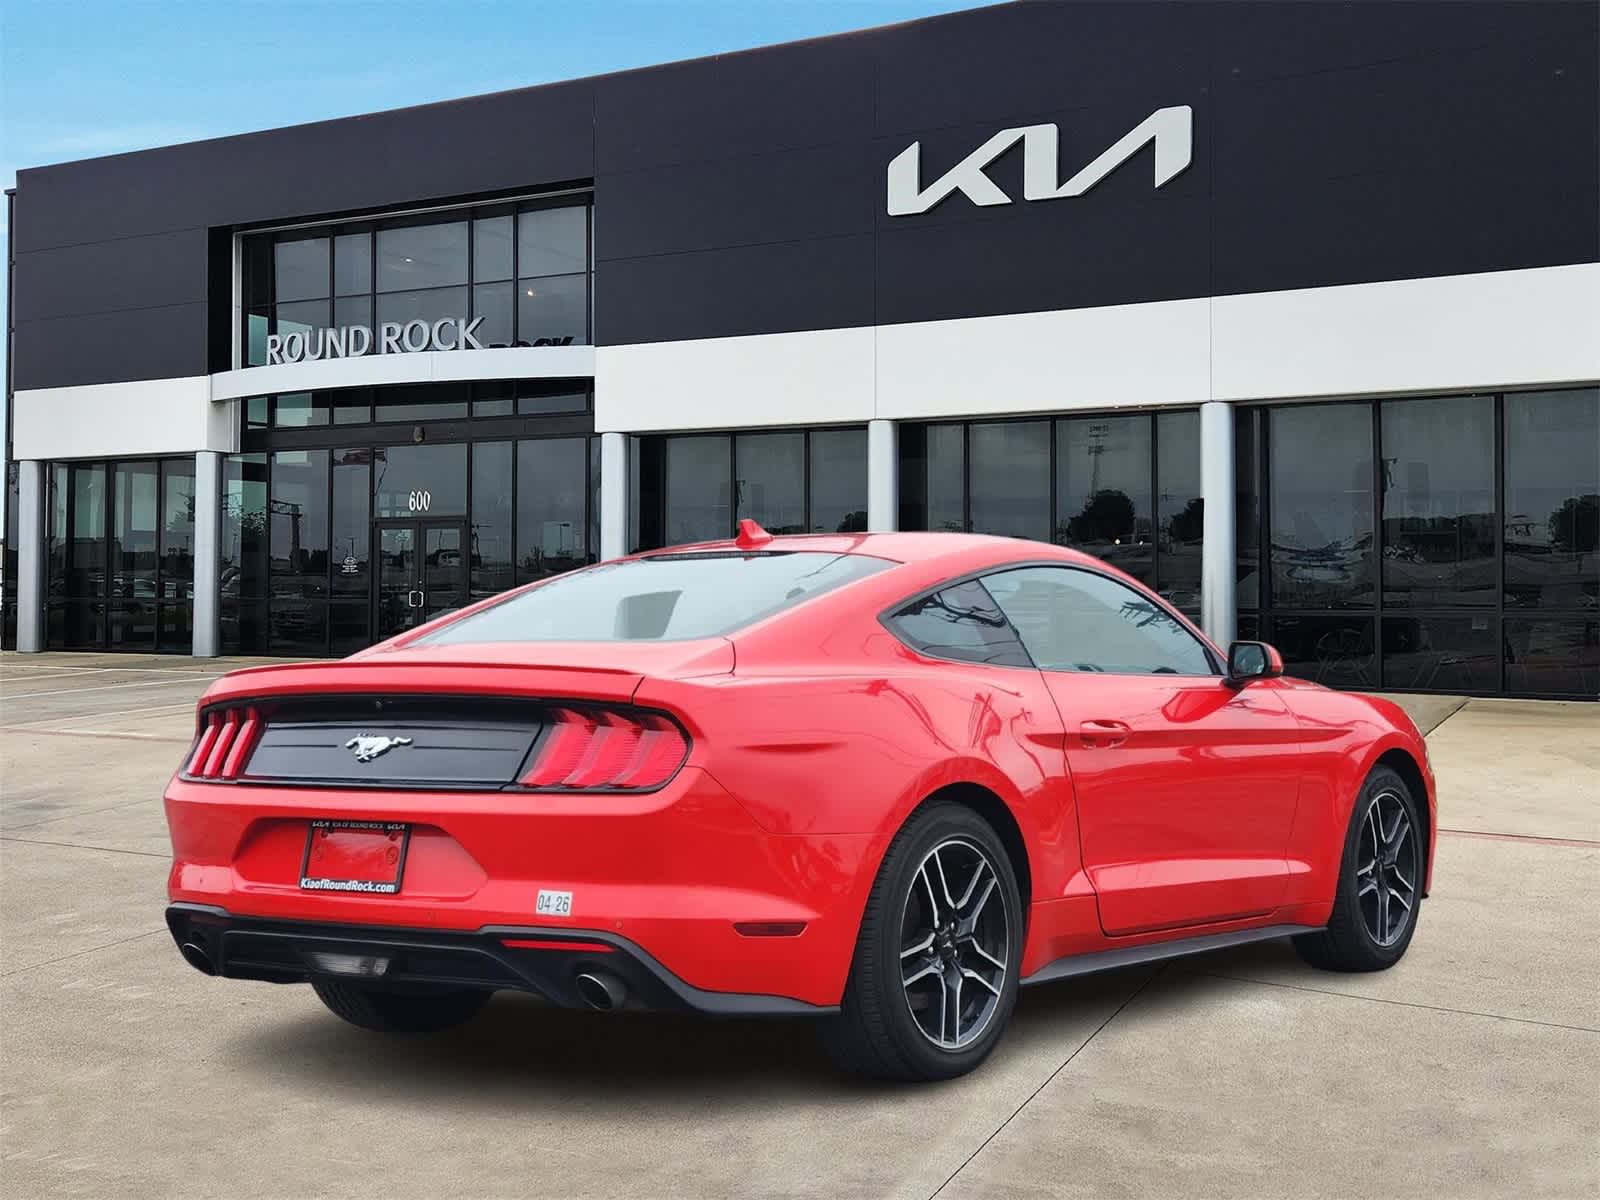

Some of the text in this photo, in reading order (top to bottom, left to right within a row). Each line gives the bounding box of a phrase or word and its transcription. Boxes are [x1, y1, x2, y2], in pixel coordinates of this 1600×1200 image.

[887, 105, 1193, 216] KIA
[266, 316, 486, 365] ROUND ROCK
[408, 490, 431, 511] 600
[300, 878, 396, 893] KiaofRoundRock.com
[537, 894, 570, 912] 04 26
